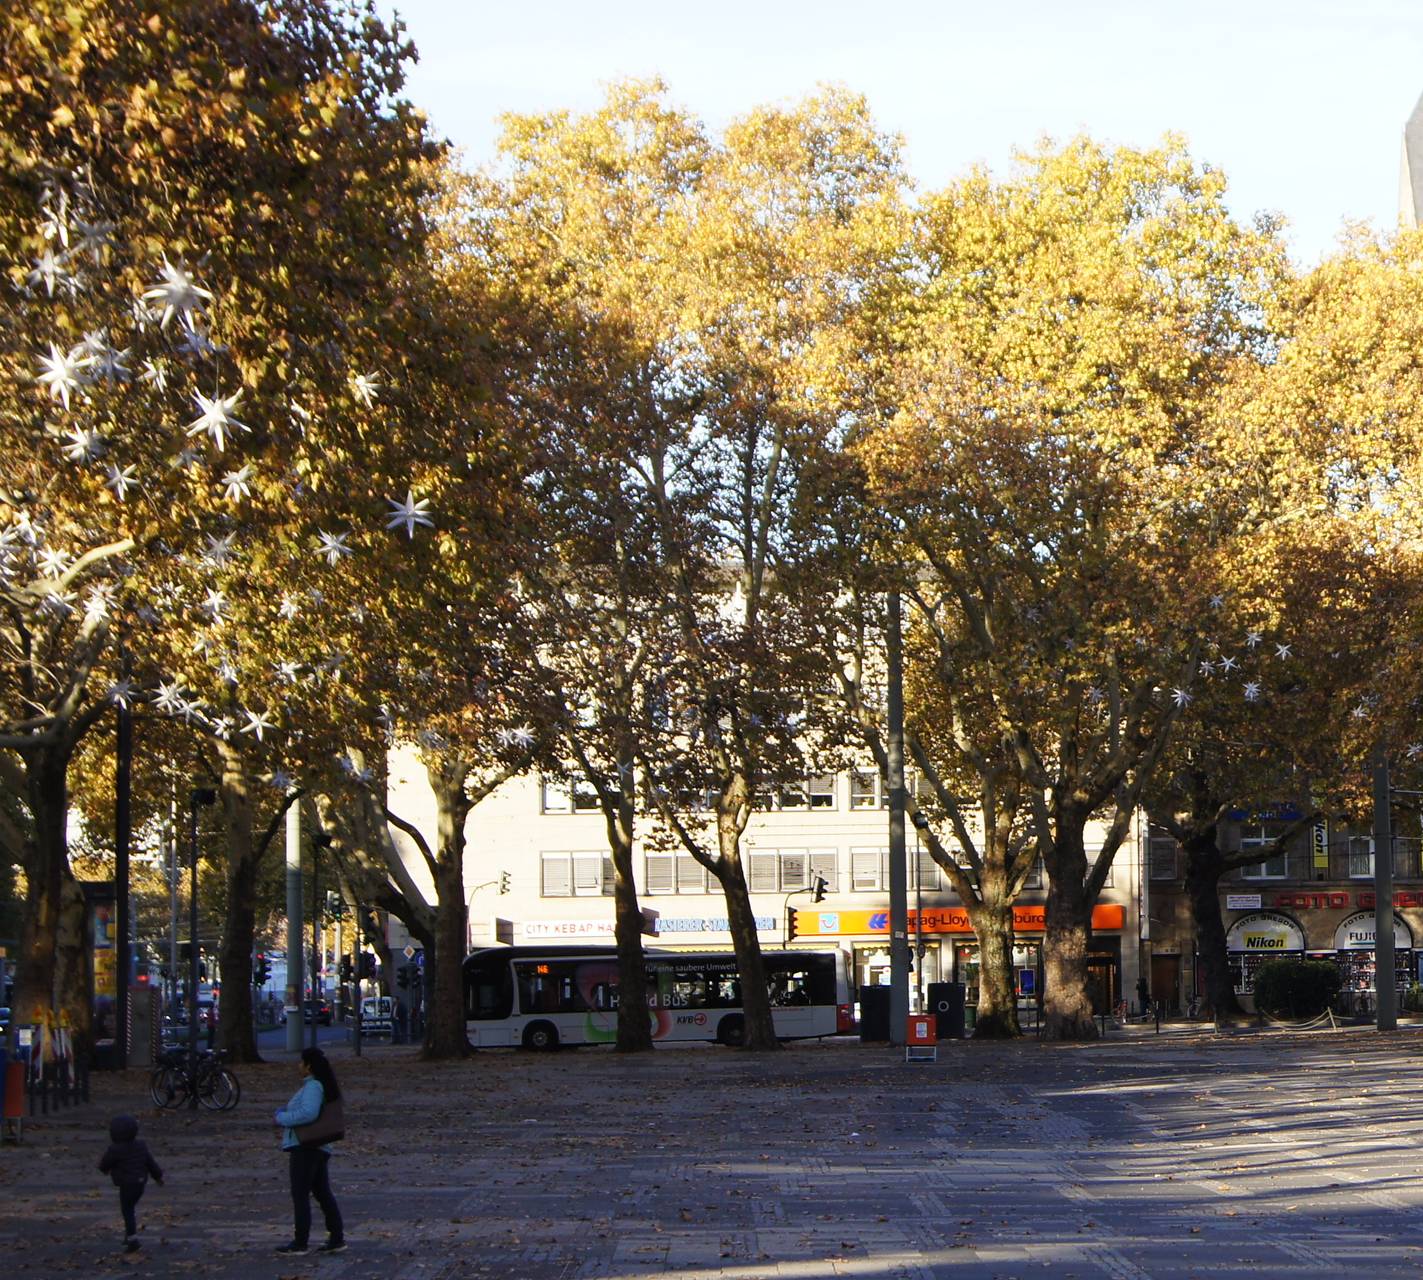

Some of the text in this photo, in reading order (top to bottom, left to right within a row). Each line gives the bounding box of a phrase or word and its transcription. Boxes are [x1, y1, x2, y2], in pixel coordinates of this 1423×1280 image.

[906, 913, 970, 928] apag-Lloy
[1343, 914, 1365, 929] FOTO
[526, 923, 614, 934] CITY KEBAP HA
[1246, 936, 1284, 948] Nikon
[706, 963, 736, 971] Umwelt
[663, 992, 688, 1006] Bus
